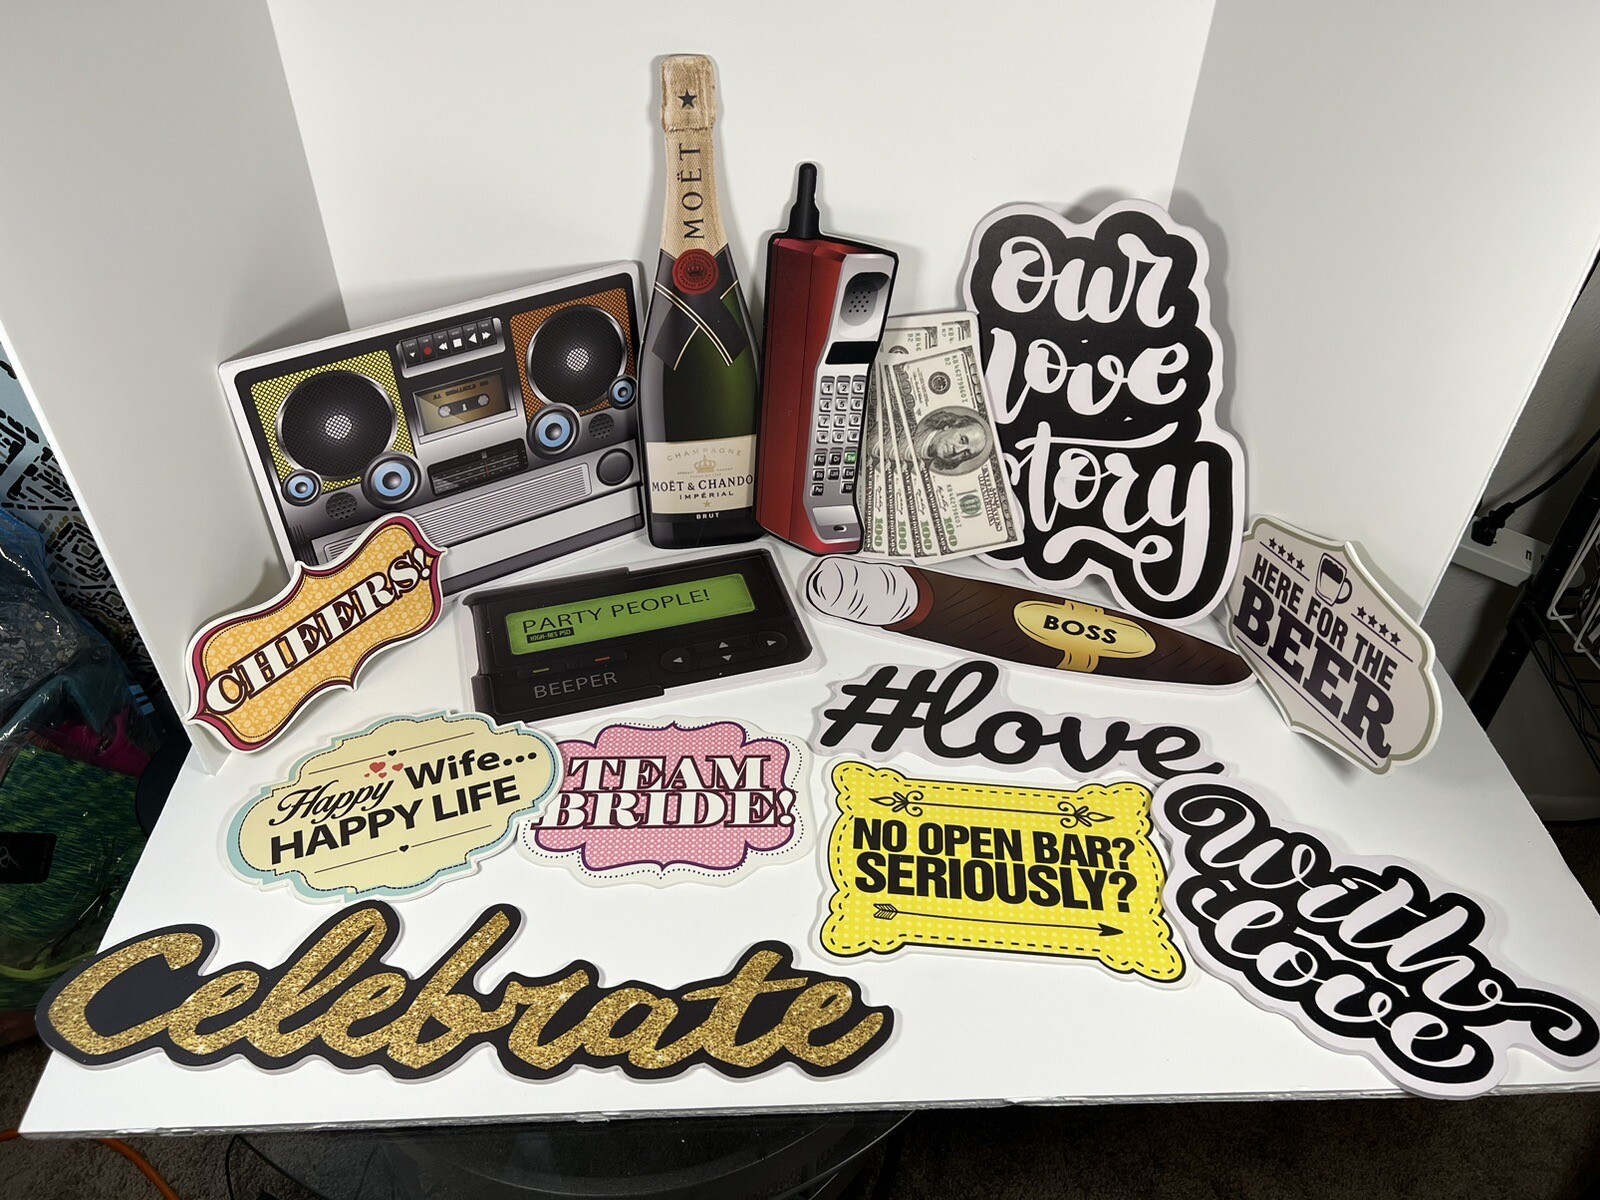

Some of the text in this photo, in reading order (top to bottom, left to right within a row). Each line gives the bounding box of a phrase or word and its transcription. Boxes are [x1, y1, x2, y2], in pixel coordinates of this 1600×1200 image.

[677, 143, 704, 239] MOËT
[991, 233, 1176, 328] our
[986, 327, 1189, 425] love
[667, 447, 742, 461] CHAMPAGNE
[652, 481, 684, 492] MOËT
[687, 483, 695, 491] &
[680, 491, 734, 500] IMPÉRIAL
[696, 512, 720, 520] BRUT
[875, 518, 883, 547] 100
[898, 521, 907, 550] 100
[921, 521, 932, 550] 100
[943, 517, 957, 546] 100
[204, 545, 431, 714] CHEERS!
[522, 588, 711, 633] PARTY PEOPLE!
[1043, 614, 1118, 645] BOSS
[1251, 553, 1398, 691] HERE FOR THE
[534, 672, 618, 699] BEEPER
[1232, 574, 1395, 759] BEER
[819, 659, 1226, 780] #love
[567, 755, 771, 791] TEAM
[268, 779, 394, 826] Happy
[270, 775, 521, 865] HAPPY LIFE
[530, 788, 797, 830] BRIDE!
[852, 817, 1136, 870] NO OPEN BAR?
[854, 851, 1138, 913] SERIOUSLY?
[46, 908, 885, 1071] Celebrate
